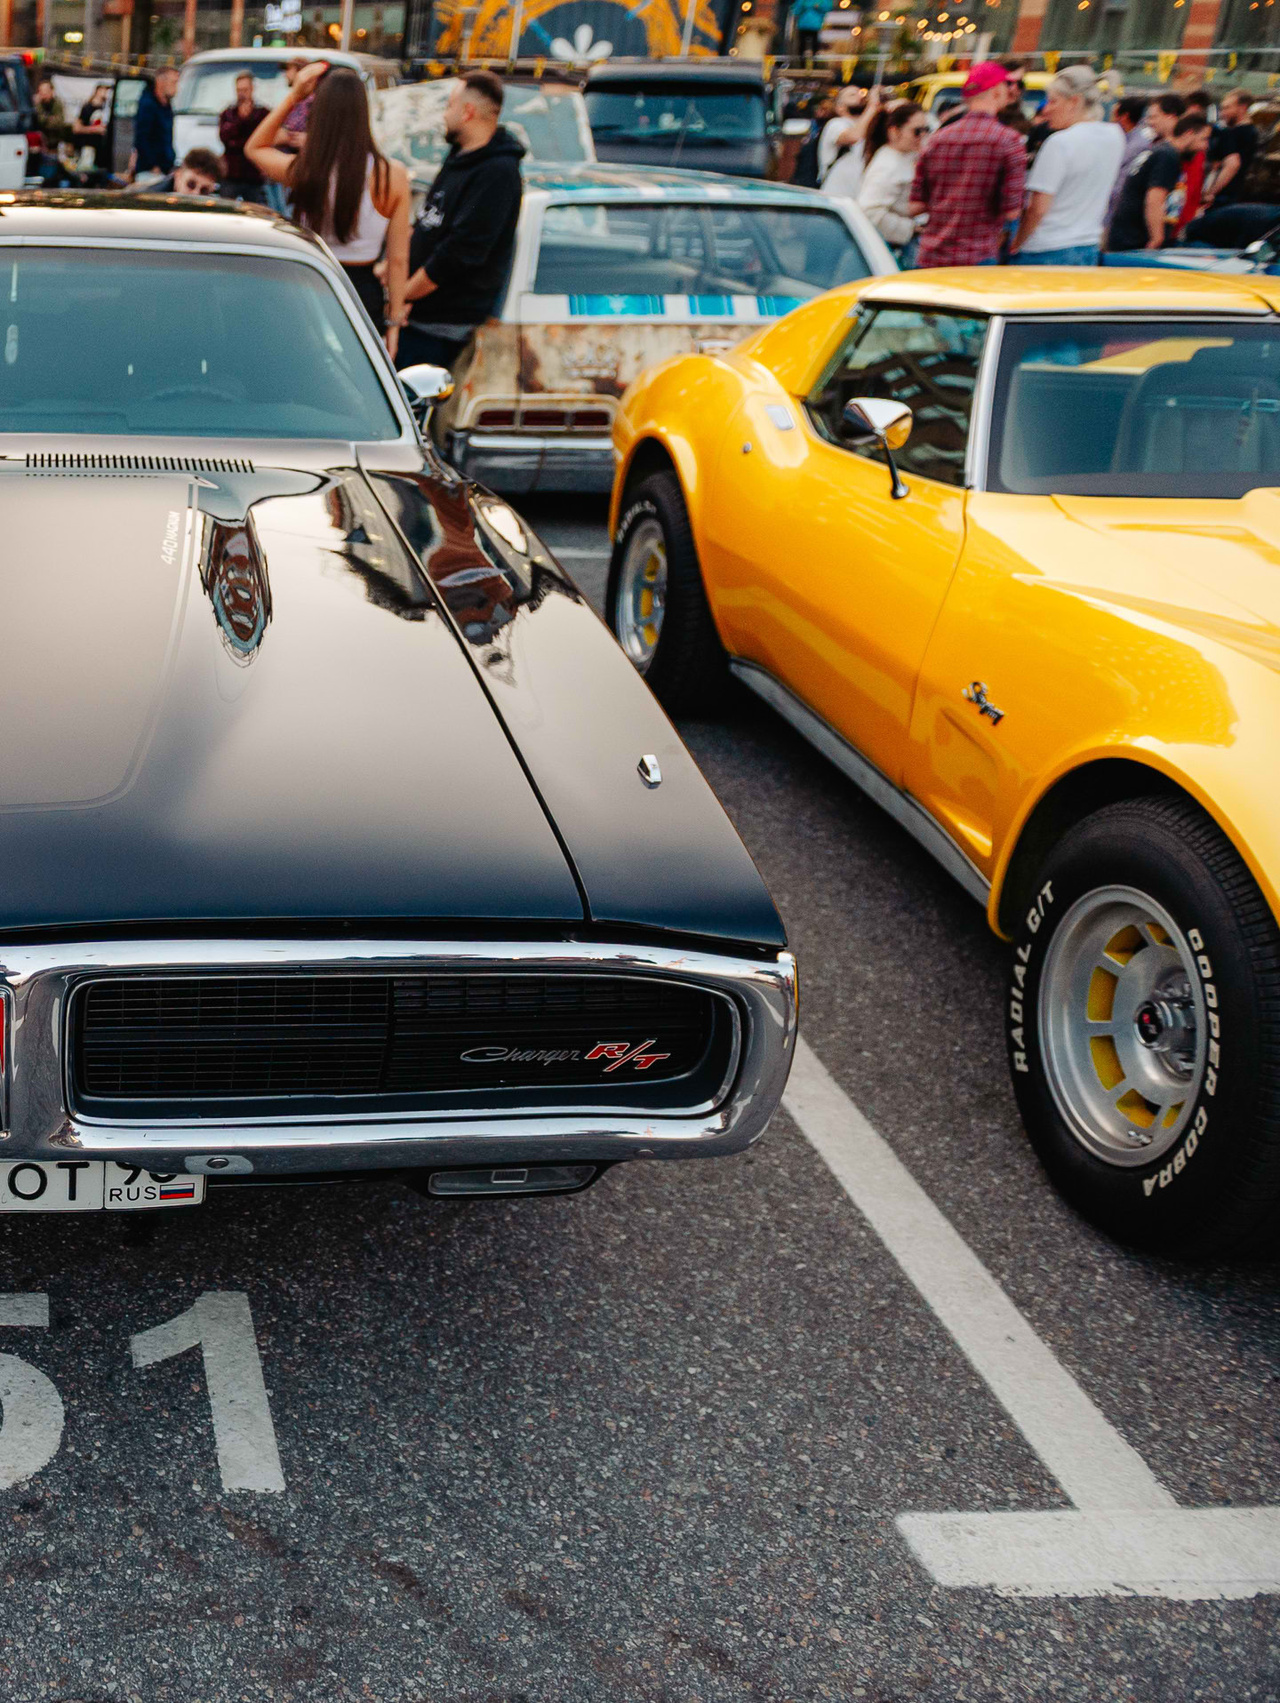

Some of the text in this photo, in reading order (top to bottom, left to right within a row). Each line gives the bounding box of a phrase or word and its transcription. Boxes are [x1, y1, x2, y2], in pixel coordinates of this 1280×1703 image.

[160, 540, 178, 565] 440
[1011, 880, 1054, 1073] RADIAL G/T
[460, 1039, 671, 1072] Charger R/T
[1142, 928, 1220, 1197] COOPER COBRA
[109, 1186, 157, 1202] RUS
